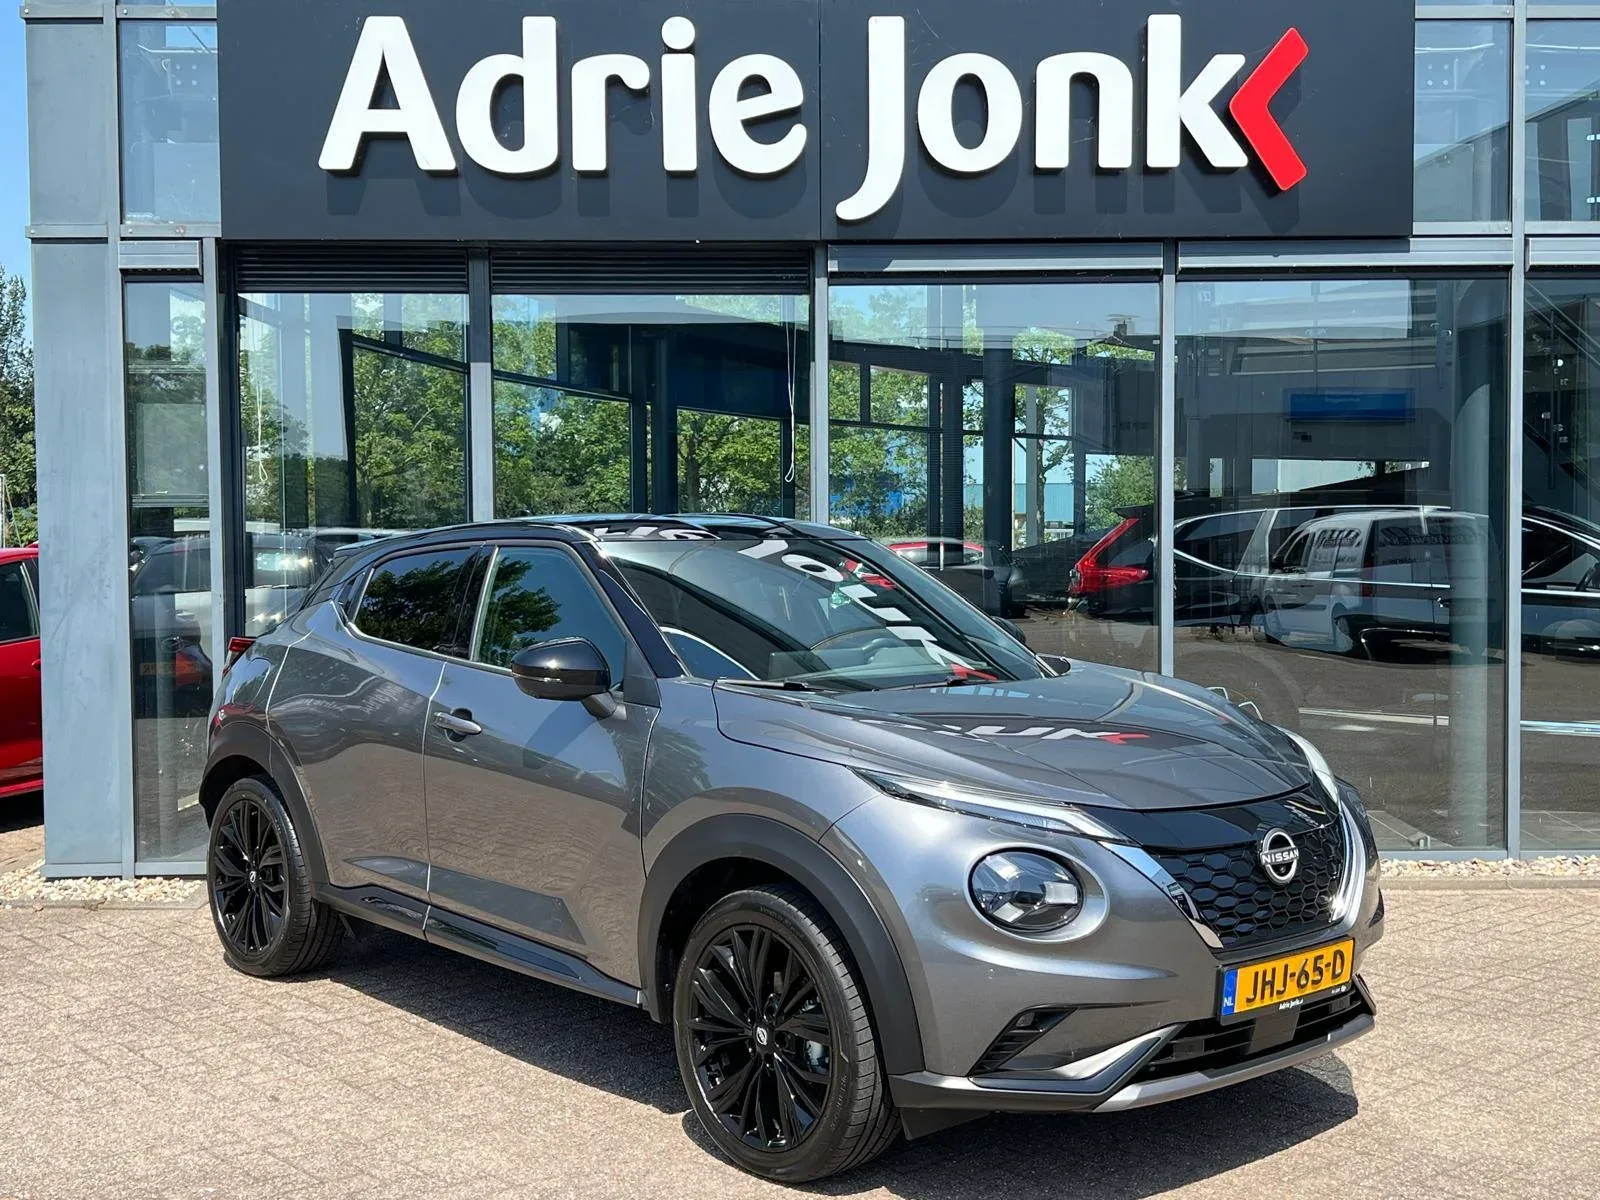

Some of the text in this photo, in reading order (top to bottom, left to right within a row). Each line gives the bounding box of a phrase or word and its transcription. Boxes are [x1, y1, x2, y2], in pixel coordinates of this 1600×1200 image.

[319, 15, 1248, 219] Adrie Jonk
[1261, 848, 1300, 864] NISSAN
[1245, 948, 1346, 1004] JHJ-65-D
[1223, 996, 1234, 1008] NL
